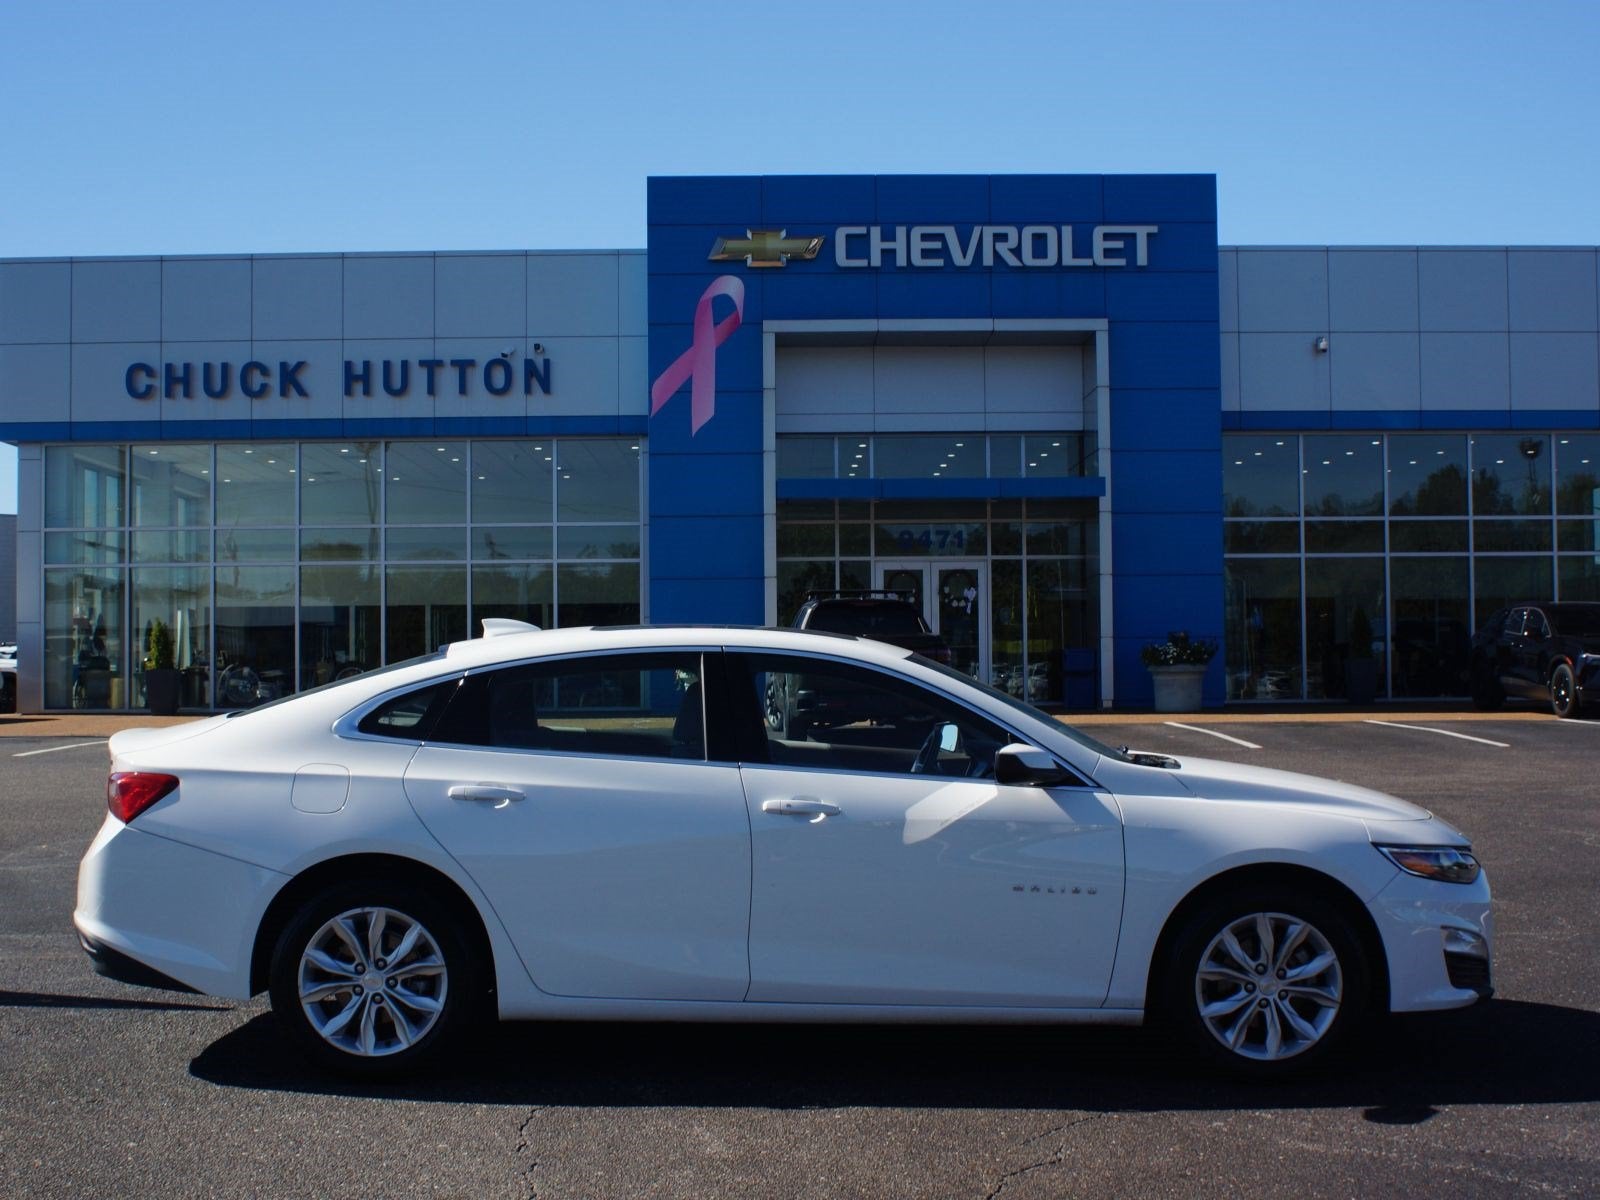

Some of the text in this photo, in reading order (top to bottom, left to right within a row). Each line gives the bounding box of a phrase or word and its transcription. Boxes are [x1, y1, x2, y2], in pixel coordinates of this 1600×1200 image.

[834, 224, 1159, 268] CHEVROLET
[125, 357, 551, 400] CHUCK HUTTON
[1012, 884, 1098, 895] MALIBU
